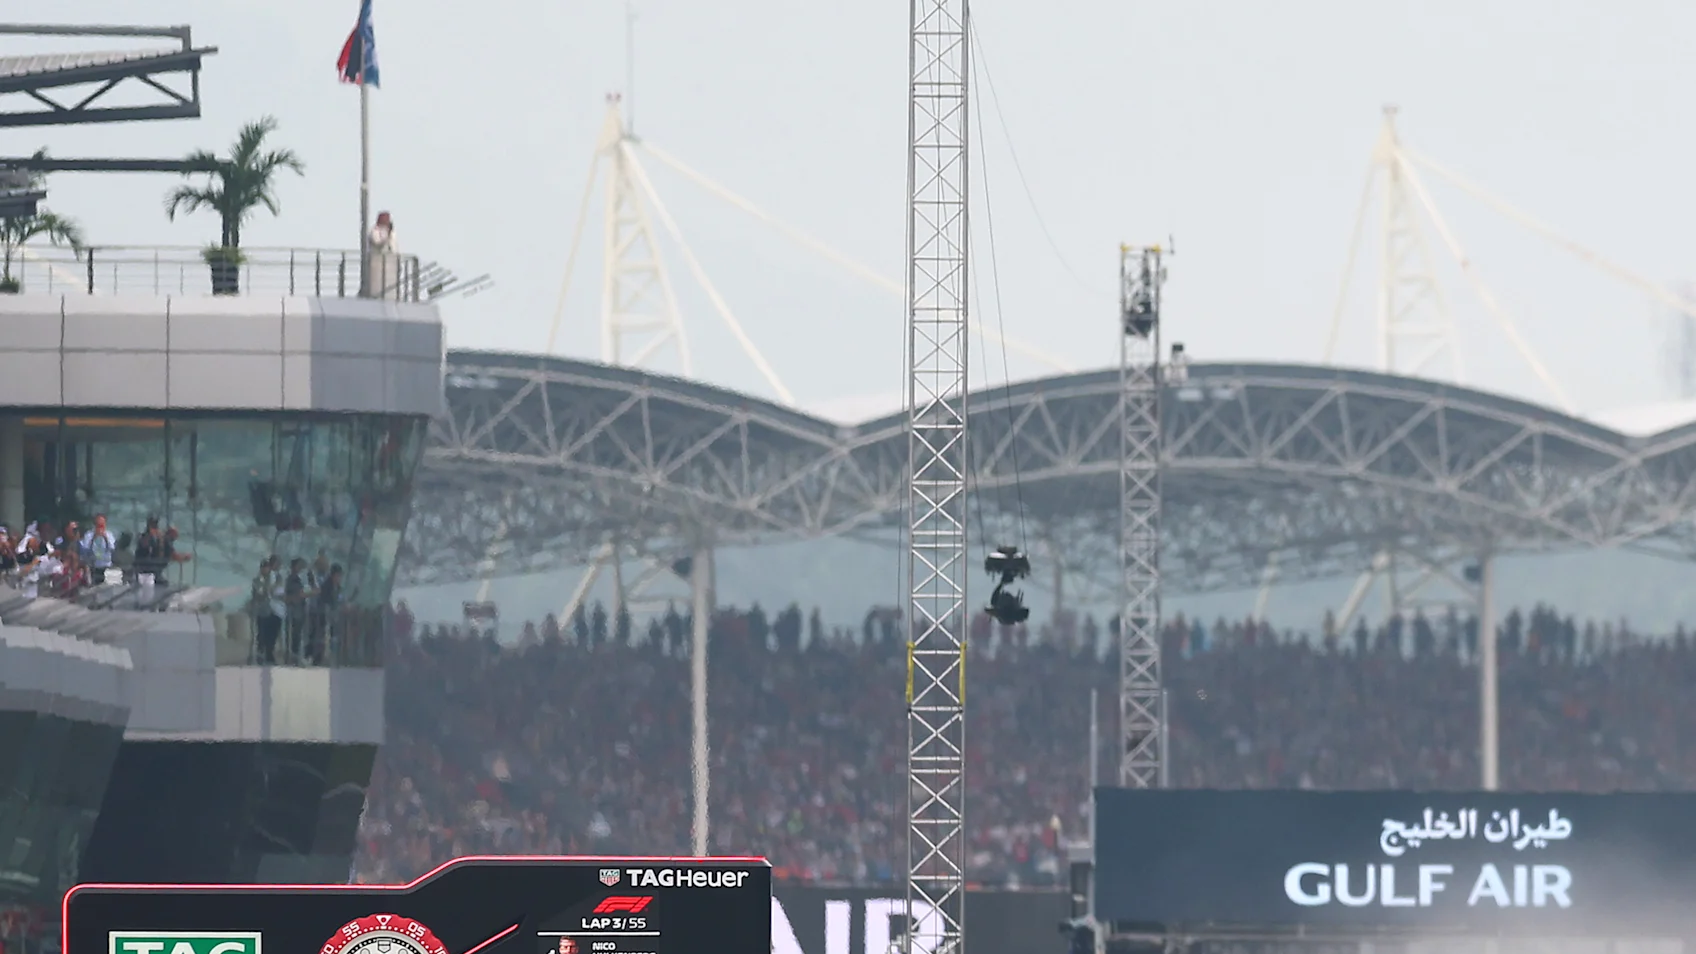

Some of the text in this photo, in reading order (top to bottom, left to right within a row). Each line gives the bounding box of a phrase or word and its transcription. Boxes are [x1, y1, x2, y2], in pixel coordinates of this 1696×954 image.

[1380, 806, 1573, 857] طيران الخليج
[1284, 863, 1573, 909] GULF AIR
[342, 922, 360, 937] 55
[407, 922, 426, 937] 05
[582, 918, 610, 929] LAP
[592, 942, 616, 951] NICO
